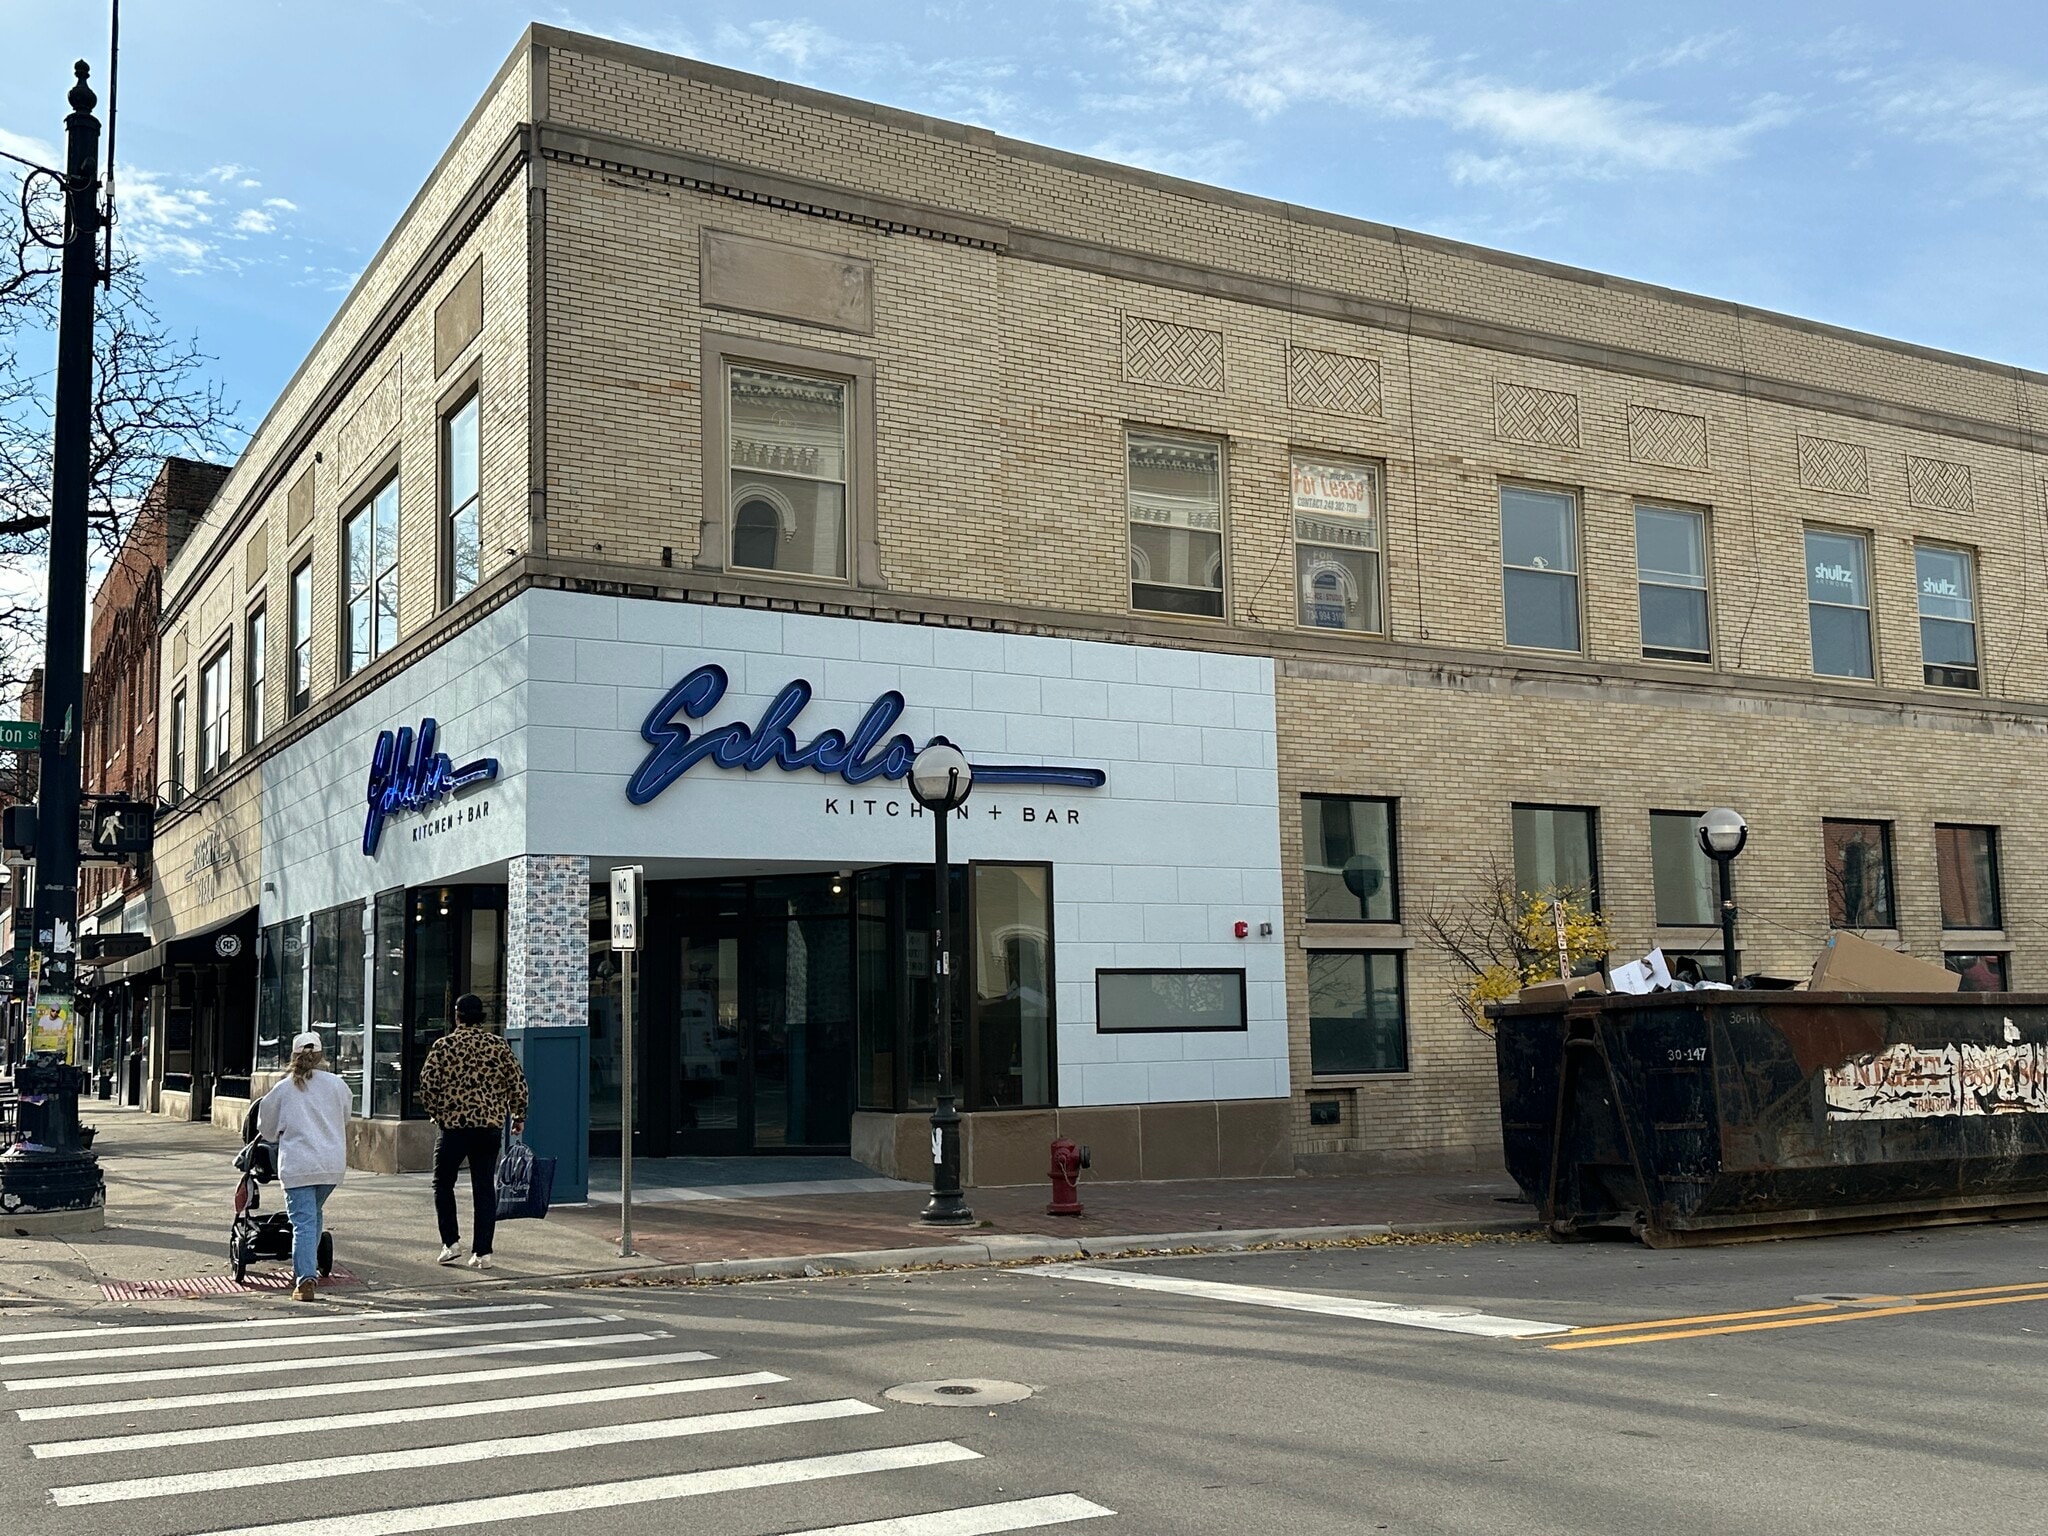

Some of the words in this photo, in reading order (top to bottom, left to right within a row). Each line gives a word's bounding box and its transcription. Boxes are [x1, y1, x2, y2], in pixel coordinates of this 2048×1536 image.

[1293, 467, 1316, 495] For
[1320, 472, 1364, 502] Lease
[1313, 551, 1333, 561] FOR
[1815, 562, 1853, 583] shultz
[1923, 576, 1958, 597] shultz
[27, 730, 37, 740] St
[624, 663, 1107, 806] Echelo
[825, 798, 969, 819] KITCHN
[1023, 807, 1079, 824] BAR
[412, 814, 453, 843] KITCHEN
[467, 801, 490, 823] BAR
[618, 877, 628, 894] NO
[615, 901, 631, 917] TURN
[613, 923, 621, 940] ON
[622, 923, 633, 940] RED
[1666, 1047, 1708, 1062] 30-147
